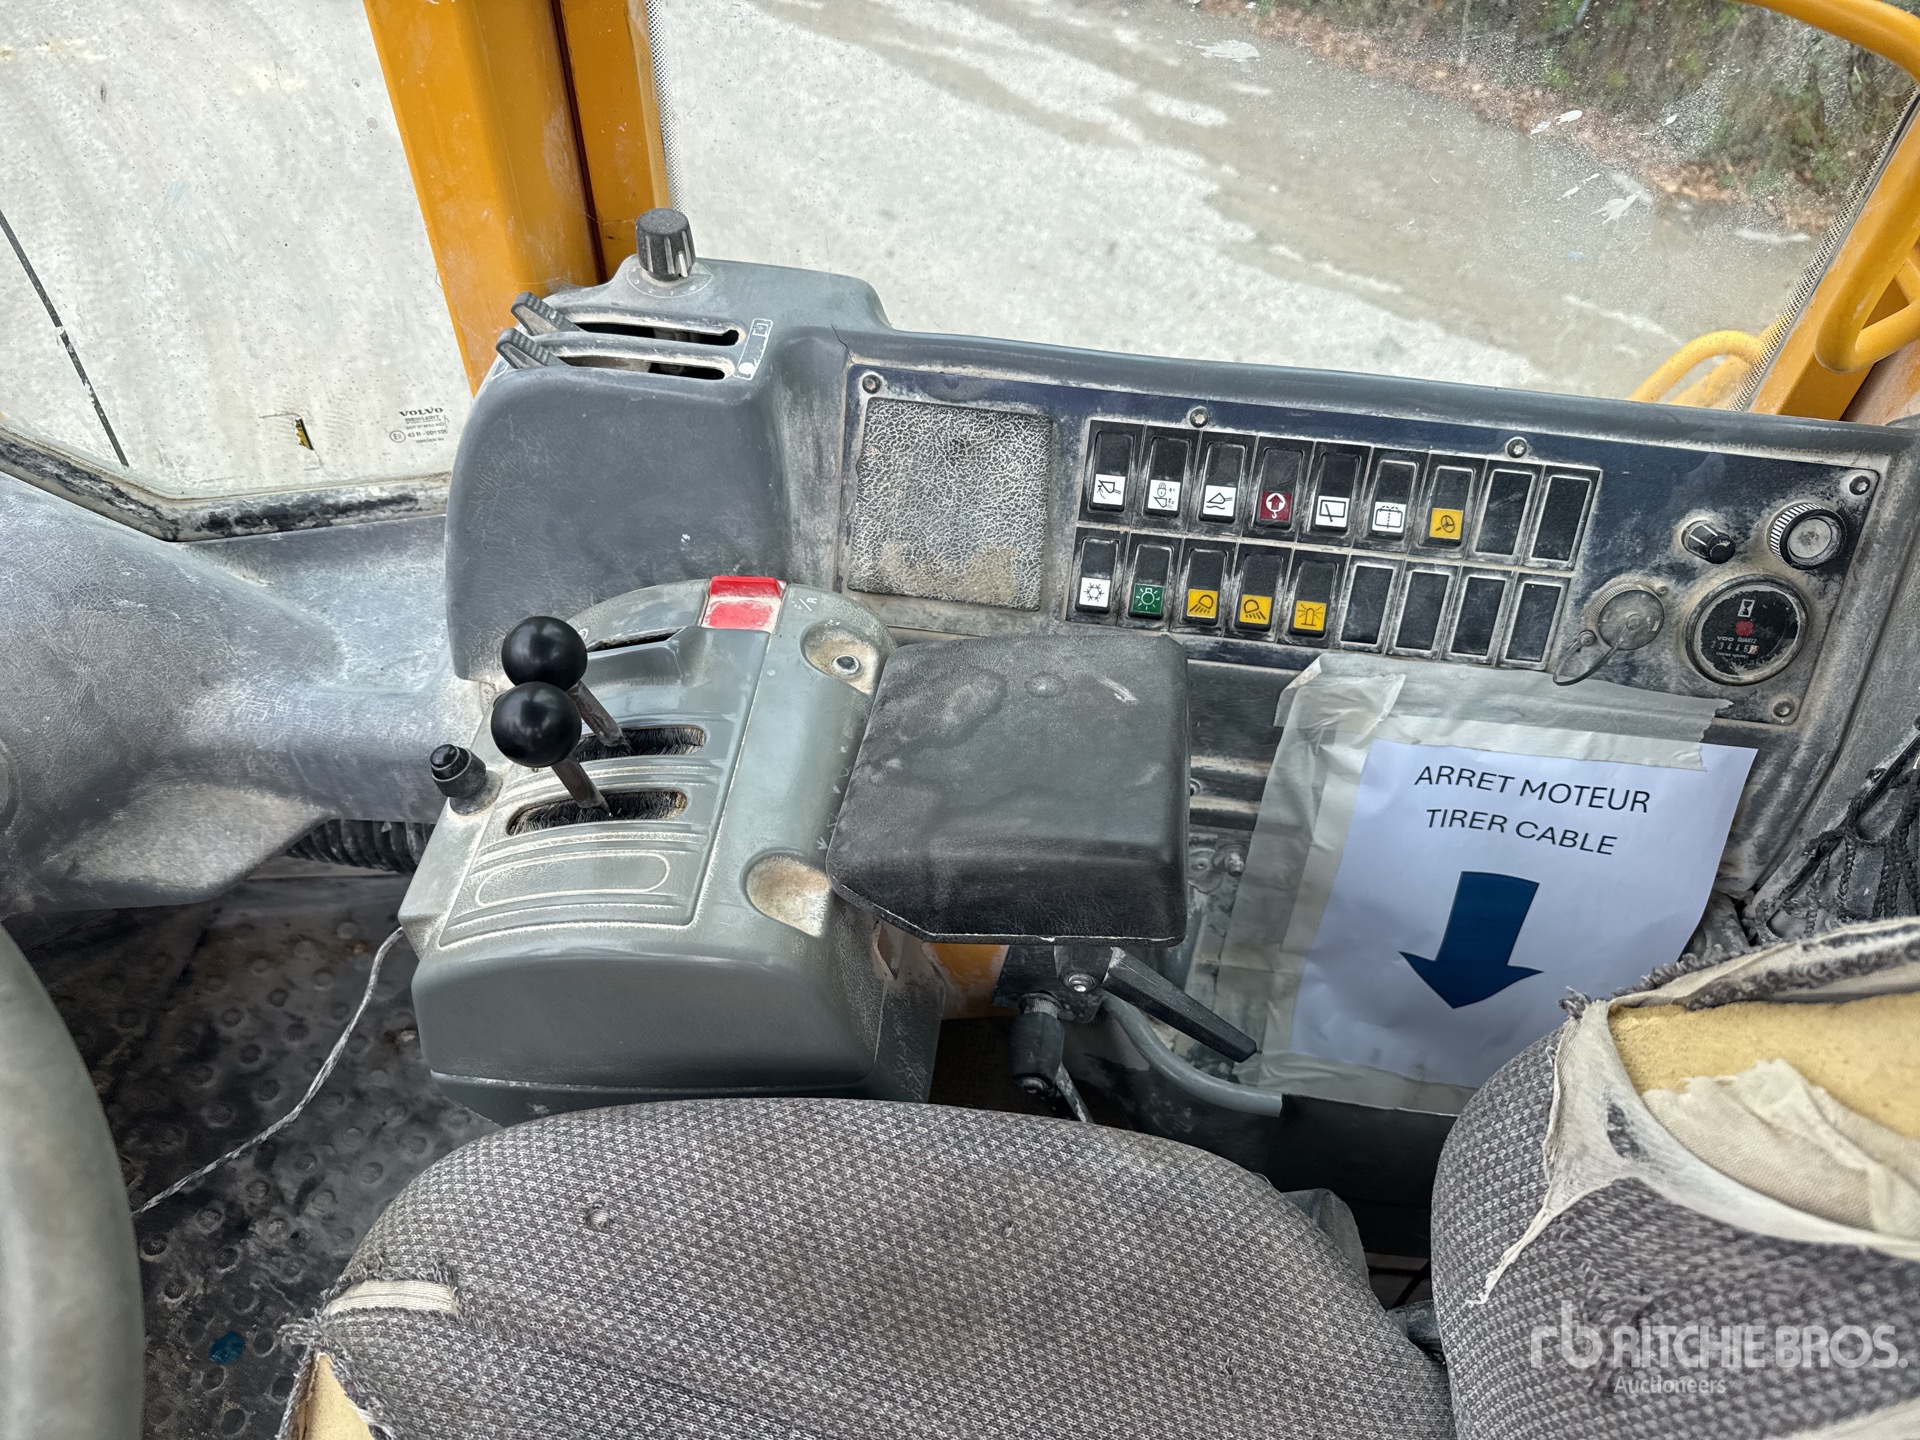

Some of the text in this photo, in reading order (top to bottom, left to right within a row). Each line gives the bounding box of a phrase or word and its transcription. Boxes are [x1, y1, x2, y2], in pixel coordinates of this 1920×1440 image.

[398, 407, 443, 417] VOLVO
[1414, 765, 1650, 813] ARRET MOTEUR
[1426, 808, 1618, 855] TIRER CABLE
